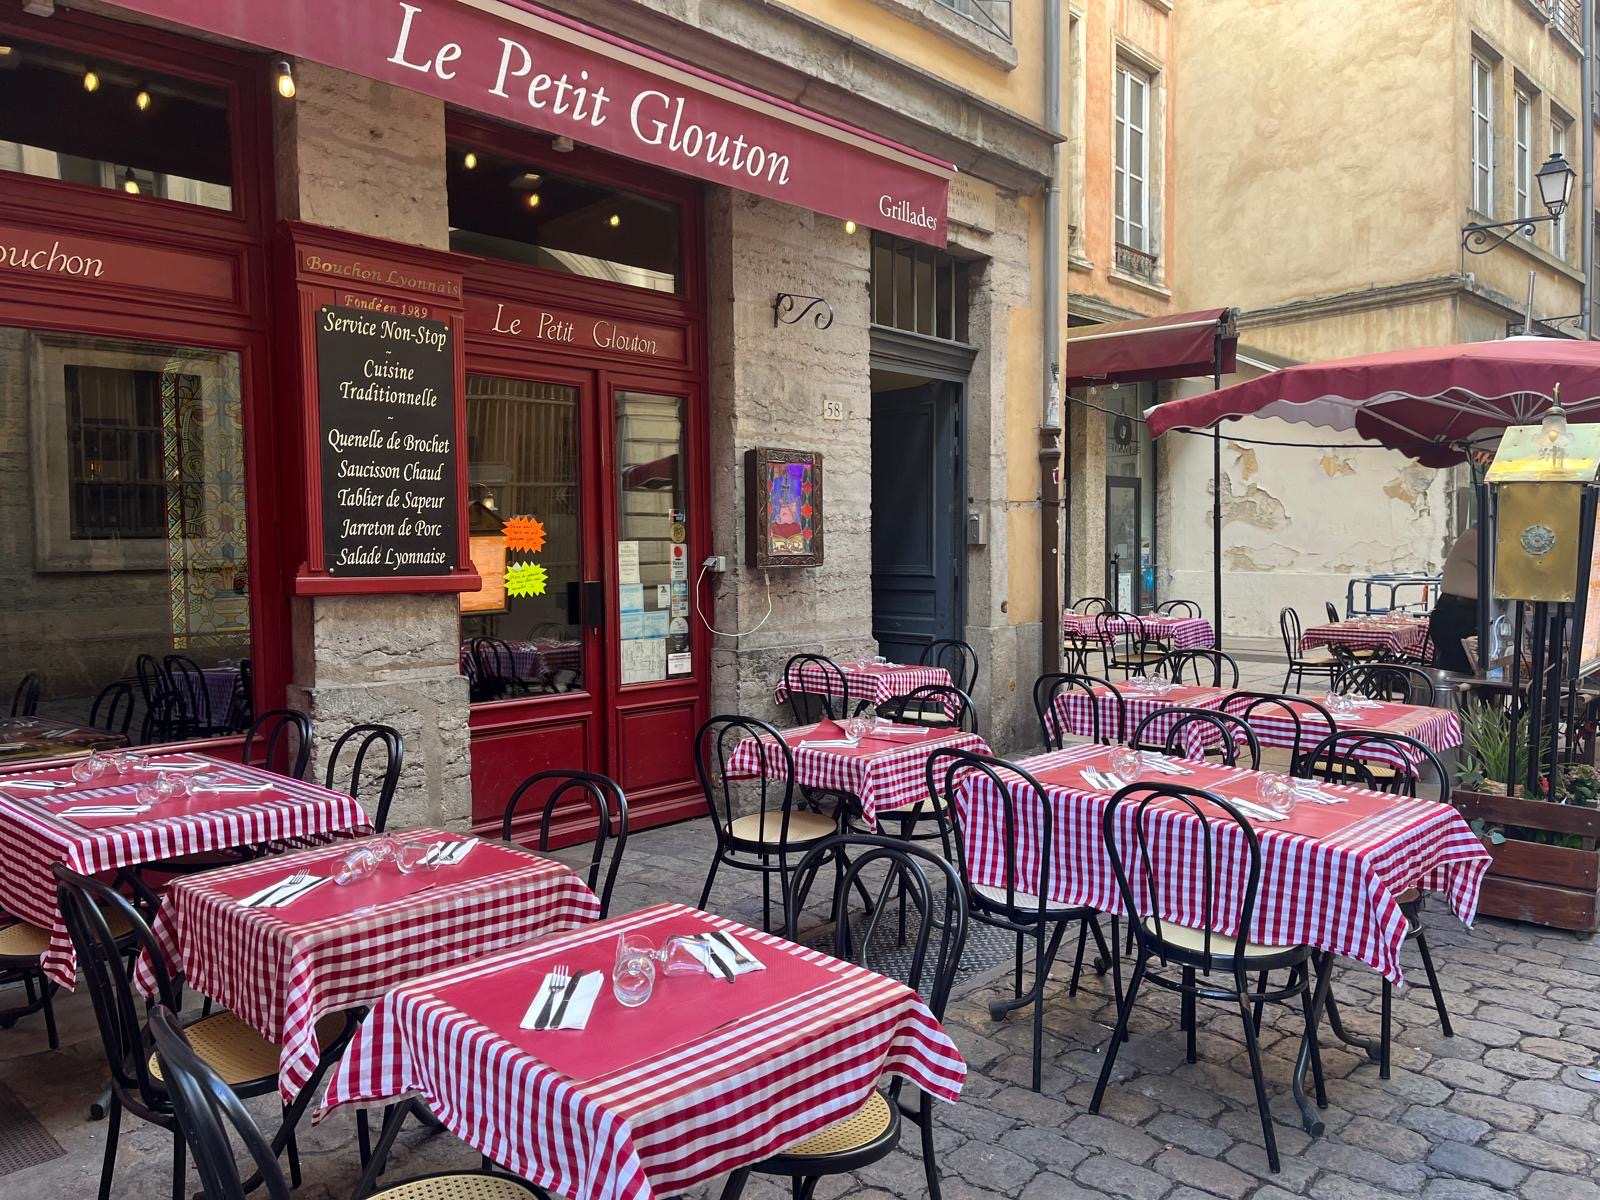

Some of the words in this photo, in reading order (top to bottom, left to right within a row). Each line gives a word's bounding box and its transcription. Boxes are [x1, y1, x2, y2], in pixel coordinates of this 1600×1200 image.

[387, 3, 462, 80] Le
[488, 37, 610, 127] Petit
[630, 90, 790, 185] Glouton
[879, 194, 938, 231] Grillades
[306, 255, 382, 281] Bouchon
[385, 270, 459, 296] Lyonnais
[383, 303, 396, 313] en
[400, 303, 428, 319] 1989
[323, 311, 377, 336] Service
[380, 320, 447, 352] Non-Stop
[491, 303, 523, 335] Le
[536, 312, 576, 343] Petit
[592, 320, 658, 355] Glouton
[363, 359, 415, 381] Cuisine
[339, 380, 438, 408] Traditionnelle
[827, 402, 841, 418] 58
[328, 428, 384, 453] Quenelle
[386, 430, 401, 450] de
[403, 434, 450, 454] Brochet
[337, 459, 401, 479] Saucisson
[403, 461, 445, 482] Chaud
[337, 487, 384, 507] Tablier
[385, 488, 400, 507] de
[402, 491, 446, 514] Sapeur
[340, 518, 395, 539] Jarreton
[398, 517, 412, 536] de
[414, 519, 442, 537] Porc
[336, 545, 381, 566] Salade
[384, 547, 446, 570] Lyonnaise
